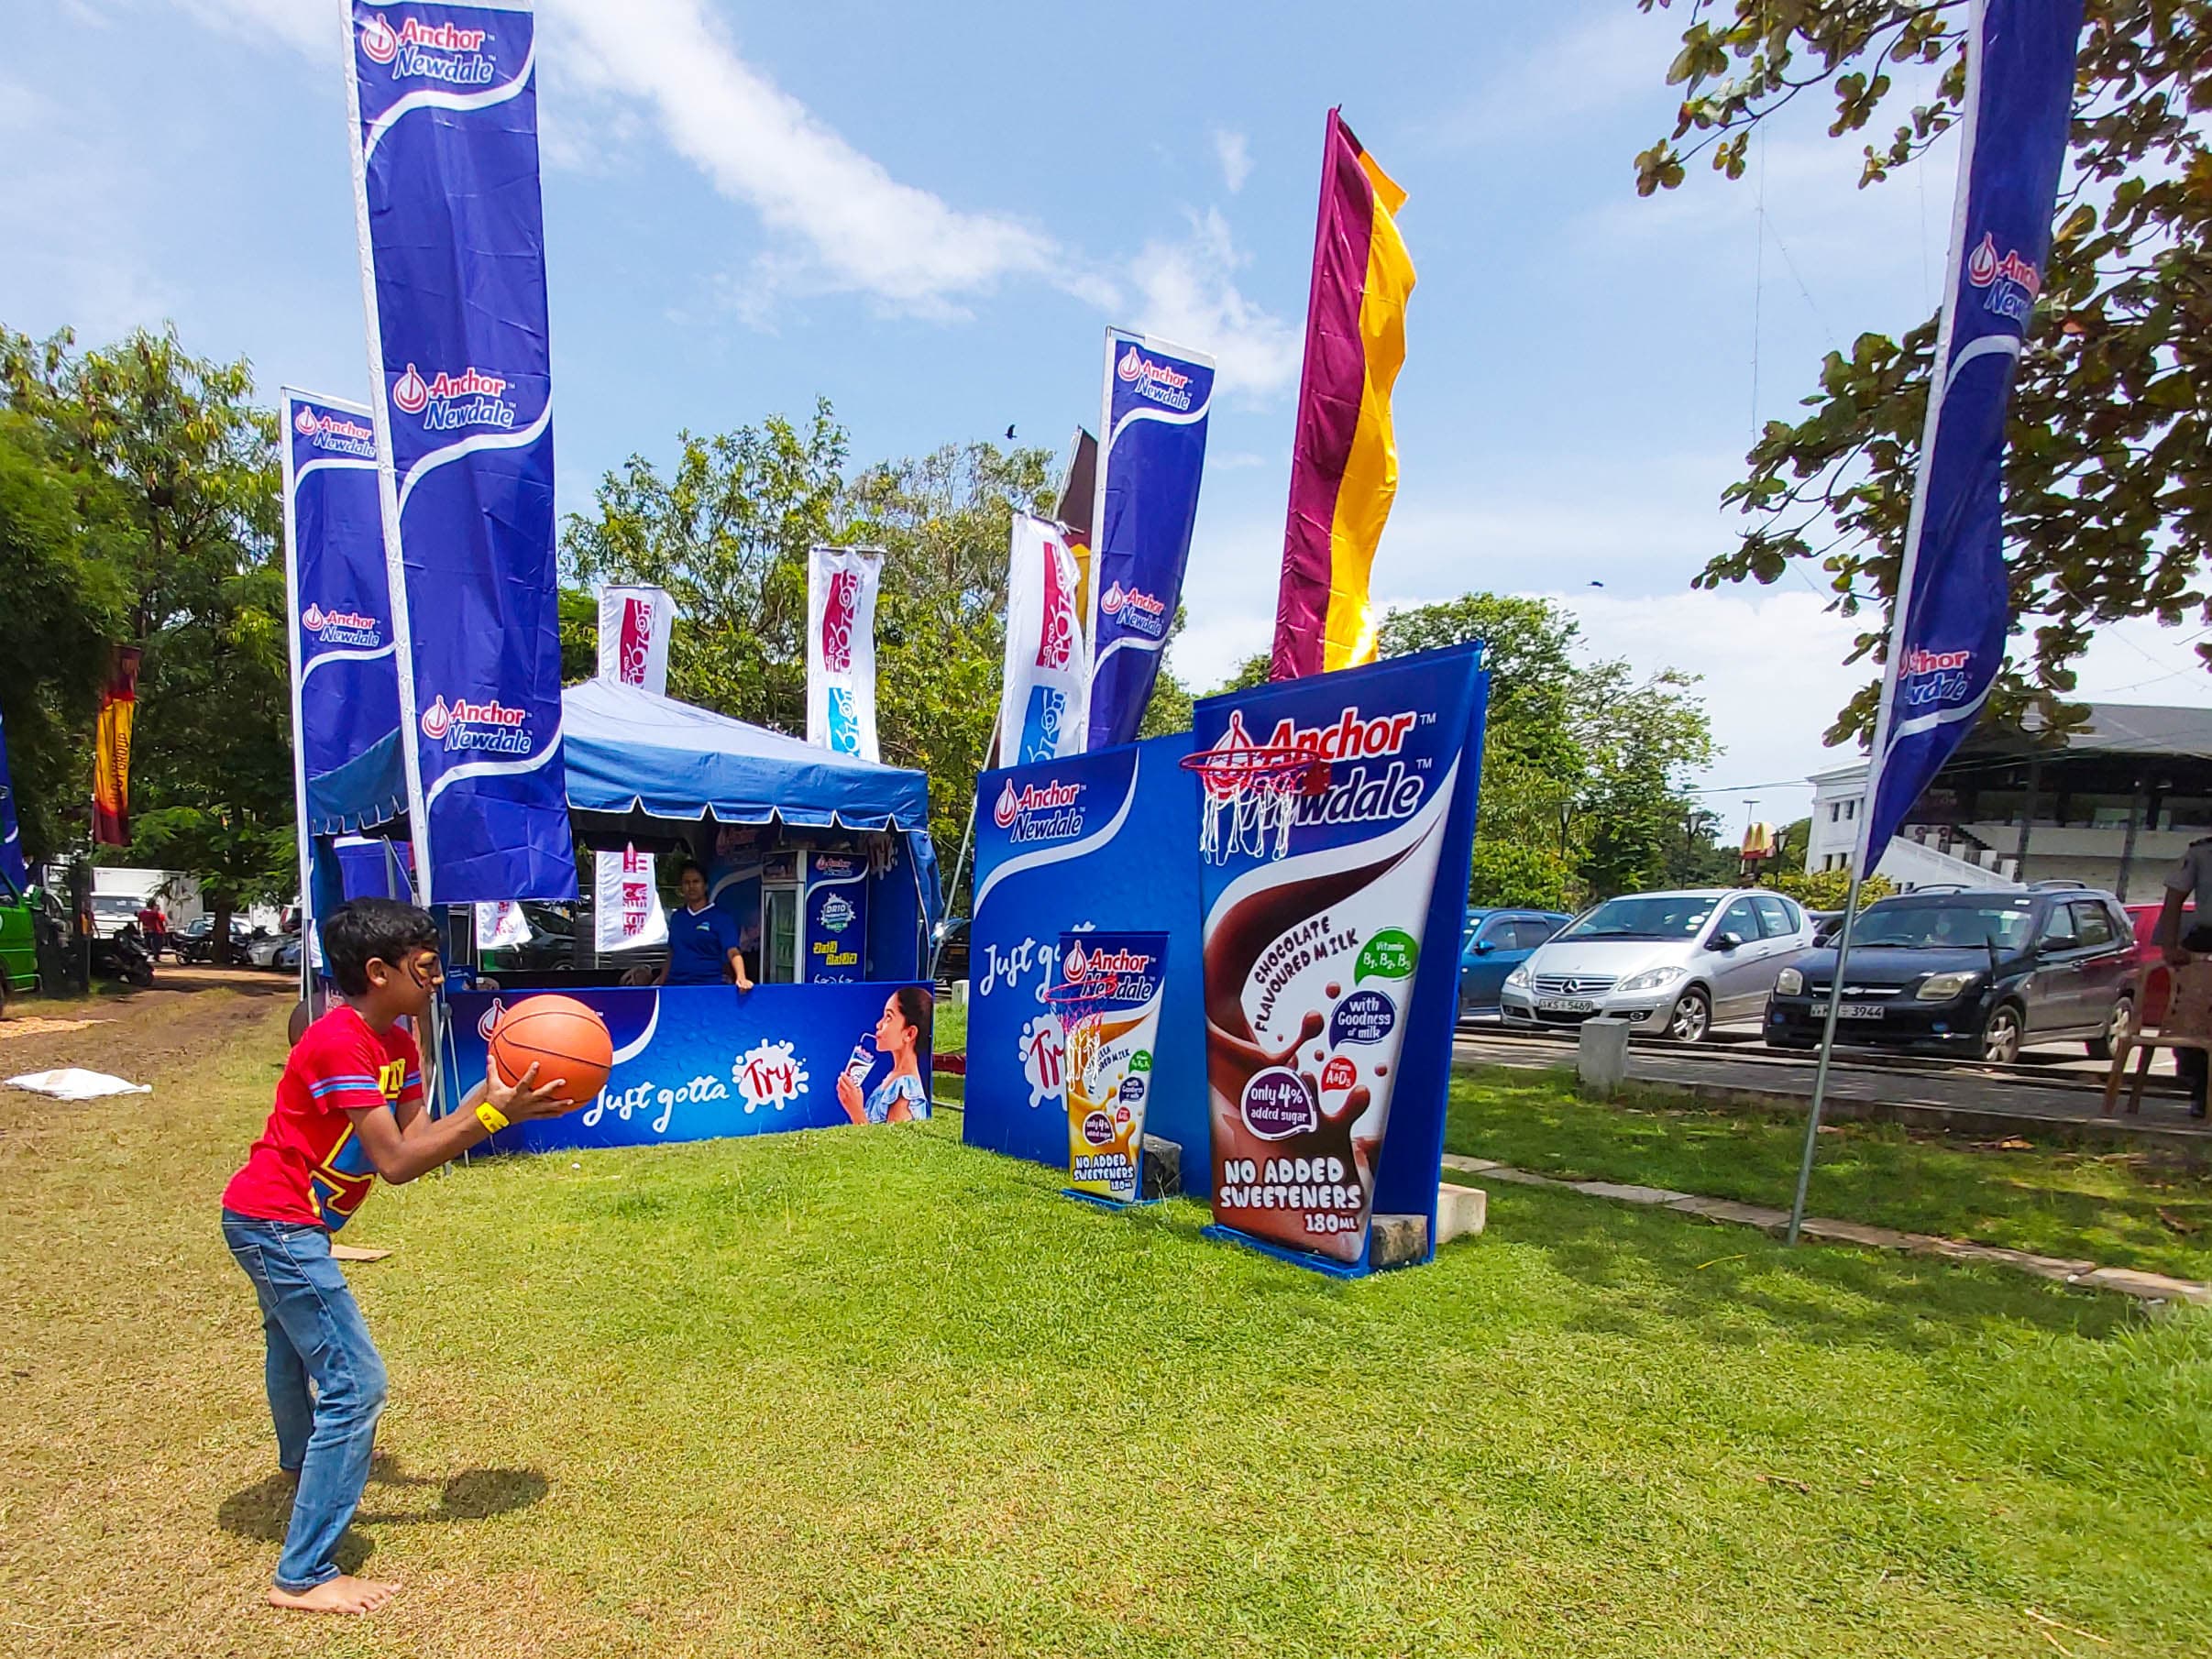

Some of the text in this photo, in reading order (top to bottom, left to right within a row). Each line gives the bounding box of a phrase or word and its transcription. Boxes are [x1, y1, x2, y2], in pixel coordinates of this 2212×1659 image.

[400, 18, 485, 50] Anchor
[392, 47, 494, 83] Newdale
[428, 368, 505, 398] Anchor
[1141, 359, 1189, 390] Anchor
[1135, 372, 1191, 411] Newdale
[318, 415, 371, 438] Anchor
[424, 397, 514, 430] Newdale
[313, 431, 377, 457] Newdale
[1124, 588, 1164, 616] Anchor
[325, 610, 376, 629] Anchor
[1116, 604, 1162, 636] Newdale
[321, 625, 380, 647] Newdale
[448, 699, 526, 726] Anchor
[116, 733, 128, 770] GROUP
[444, 725, 532, 753] Newdale
[1262, 708, 1416, 768] Anchor
[1018, 780, 1080, 811] Anchor
[1010, 808, 1083, 843] Newdale
[1085, 948, 1149, 972] Anchor
[1254, 916, 1330, 984] CHOCOLATE
[980, 938, 1036, 996] Just
[1254, 928, 1359, 1032] FLAVOURED MILK
[1338, 1011, 1392, 1026] Goodness
[1349, 997, 1379, 1012] with
[1852, 1006, 1882, 1016] 3944
[1358, 1026, 1381, 1038] milk
[1029, 1029, 1065, 1089] Tr
[743, 1058, 796, 1098] Try
[581, 1075, 730, 1133] Just gotta
[1250, 1083, 1303, 1107] only 4%
[1250, 1106, 1308, 1125] added sugar
[1073, 1166, 1134, 1181] SWEETENERS
[1075, 1153, 1127, 1169] NO ADDED
[1224, 1157, 1344, 1183] NO ADDED
[1219, 1185, 1361, 1208] SWEETENERS
[1304, 1214, 1357, 1233] 180ML
